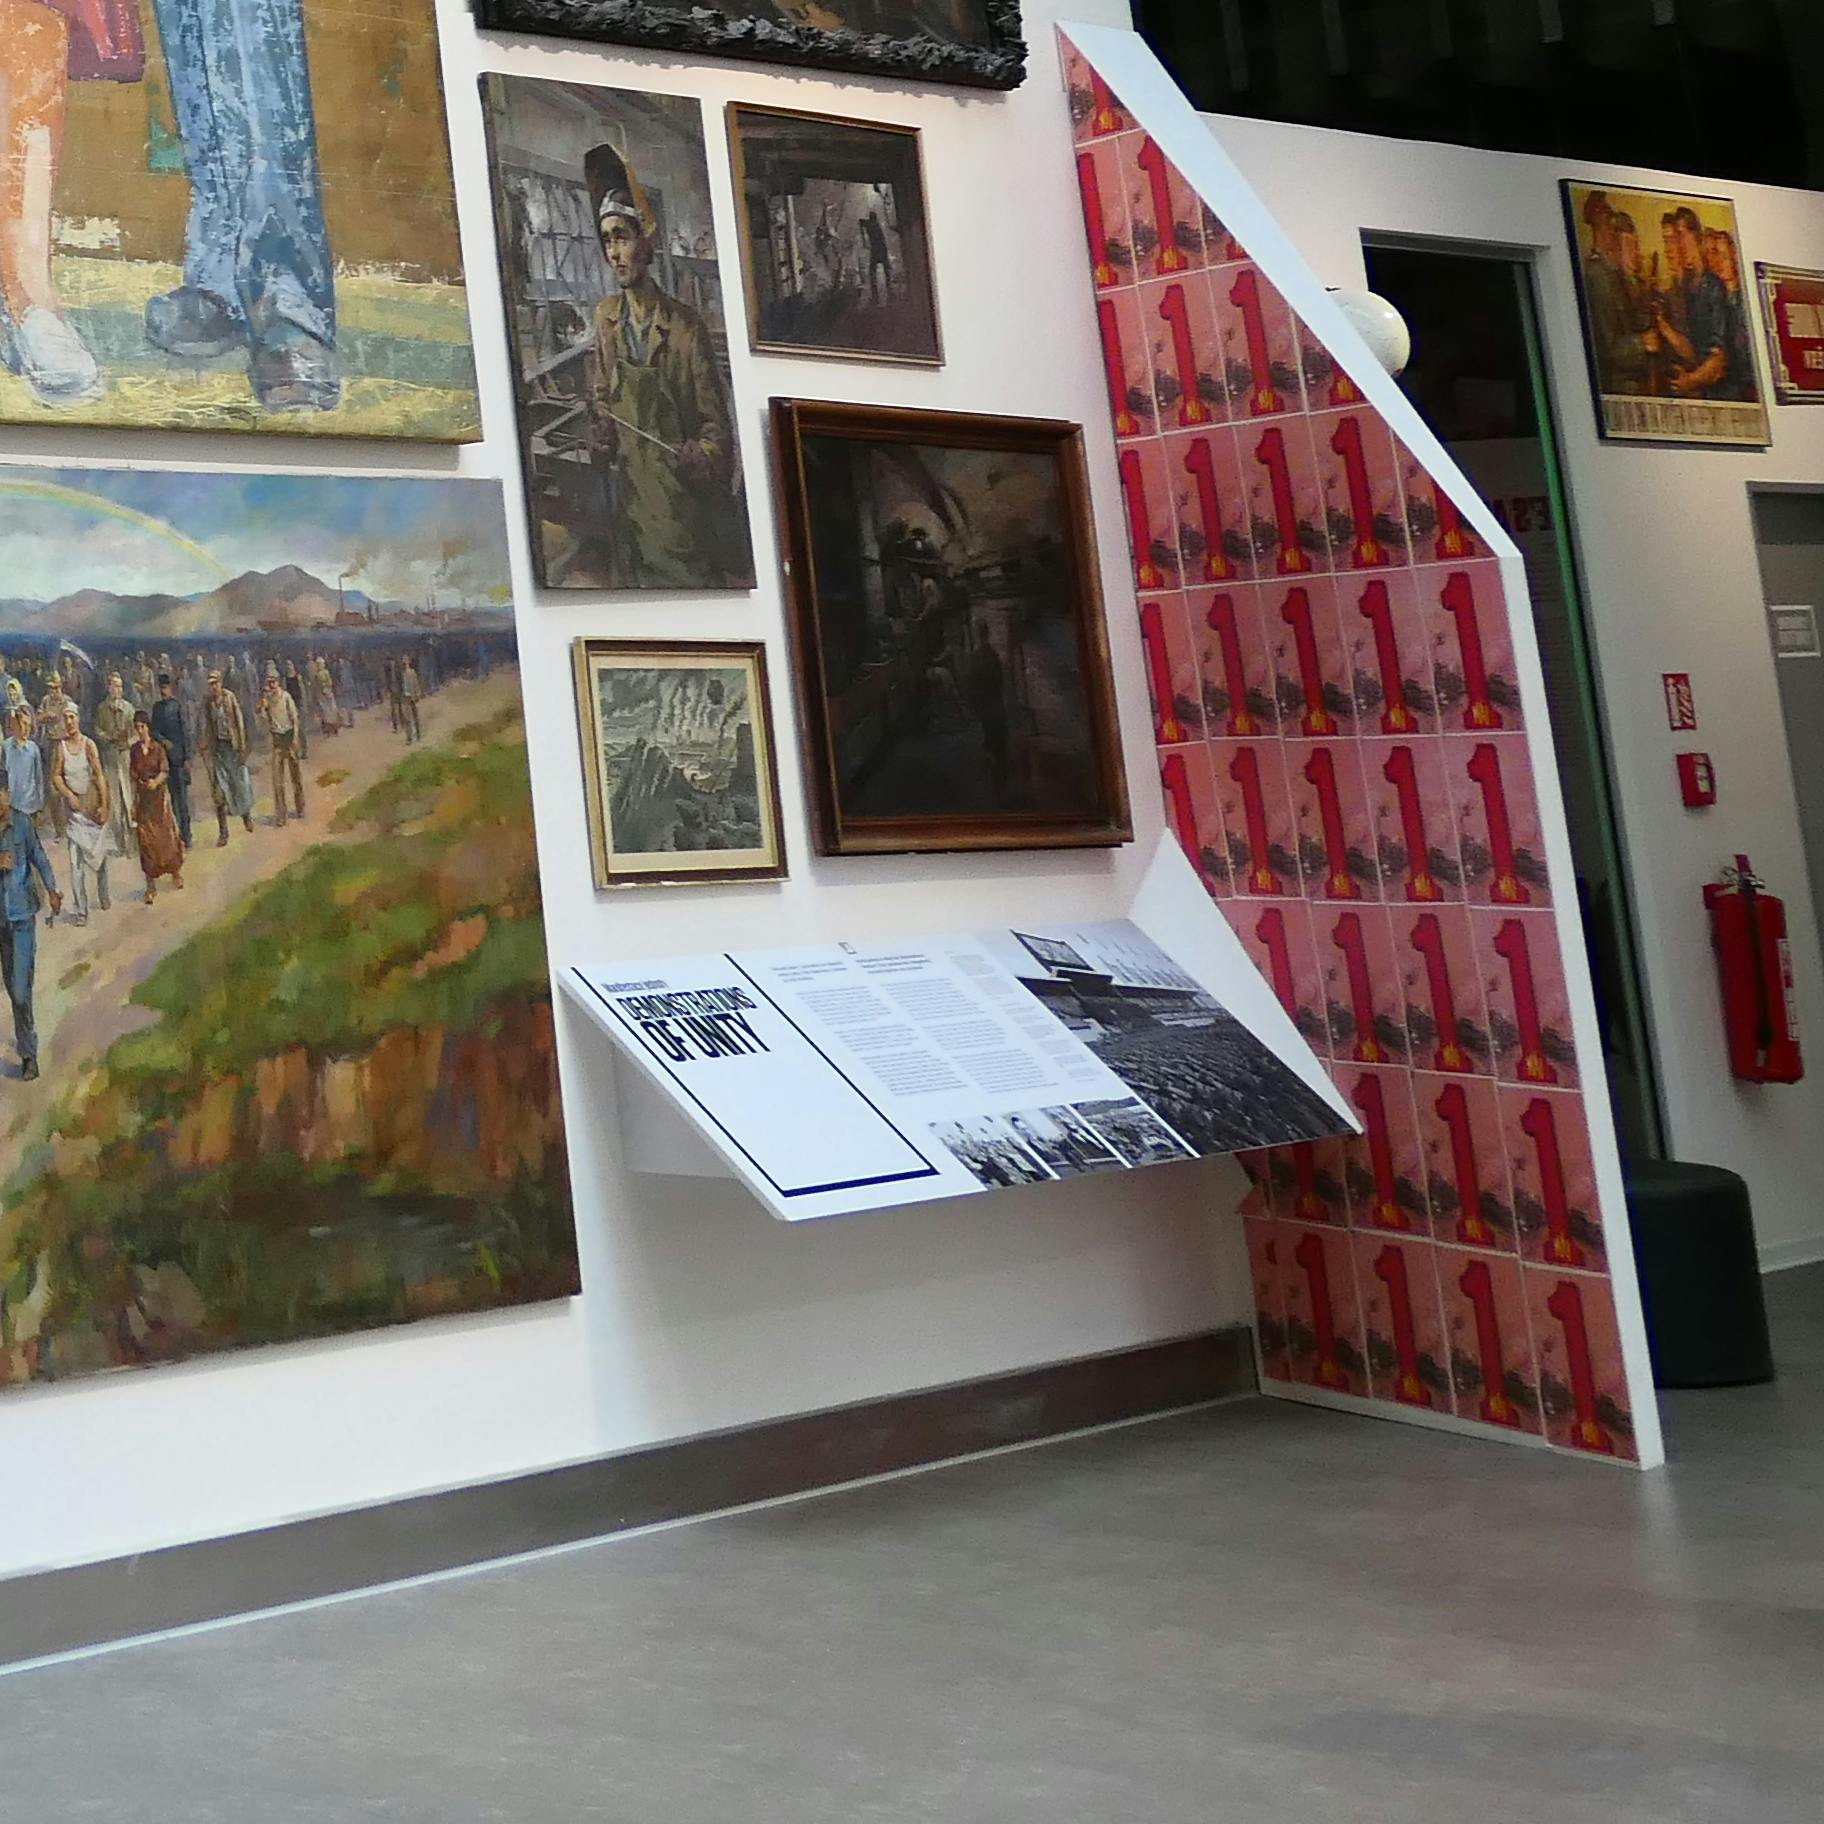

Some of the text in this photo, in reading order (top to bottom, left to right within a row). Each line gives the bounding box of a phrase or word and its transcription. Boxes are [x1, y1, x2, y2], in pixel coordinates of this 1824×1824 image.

[616, 986, 758, 1021] DEMONSTRATIONS
[639, 1011, 771, 1062] OF UNITY
